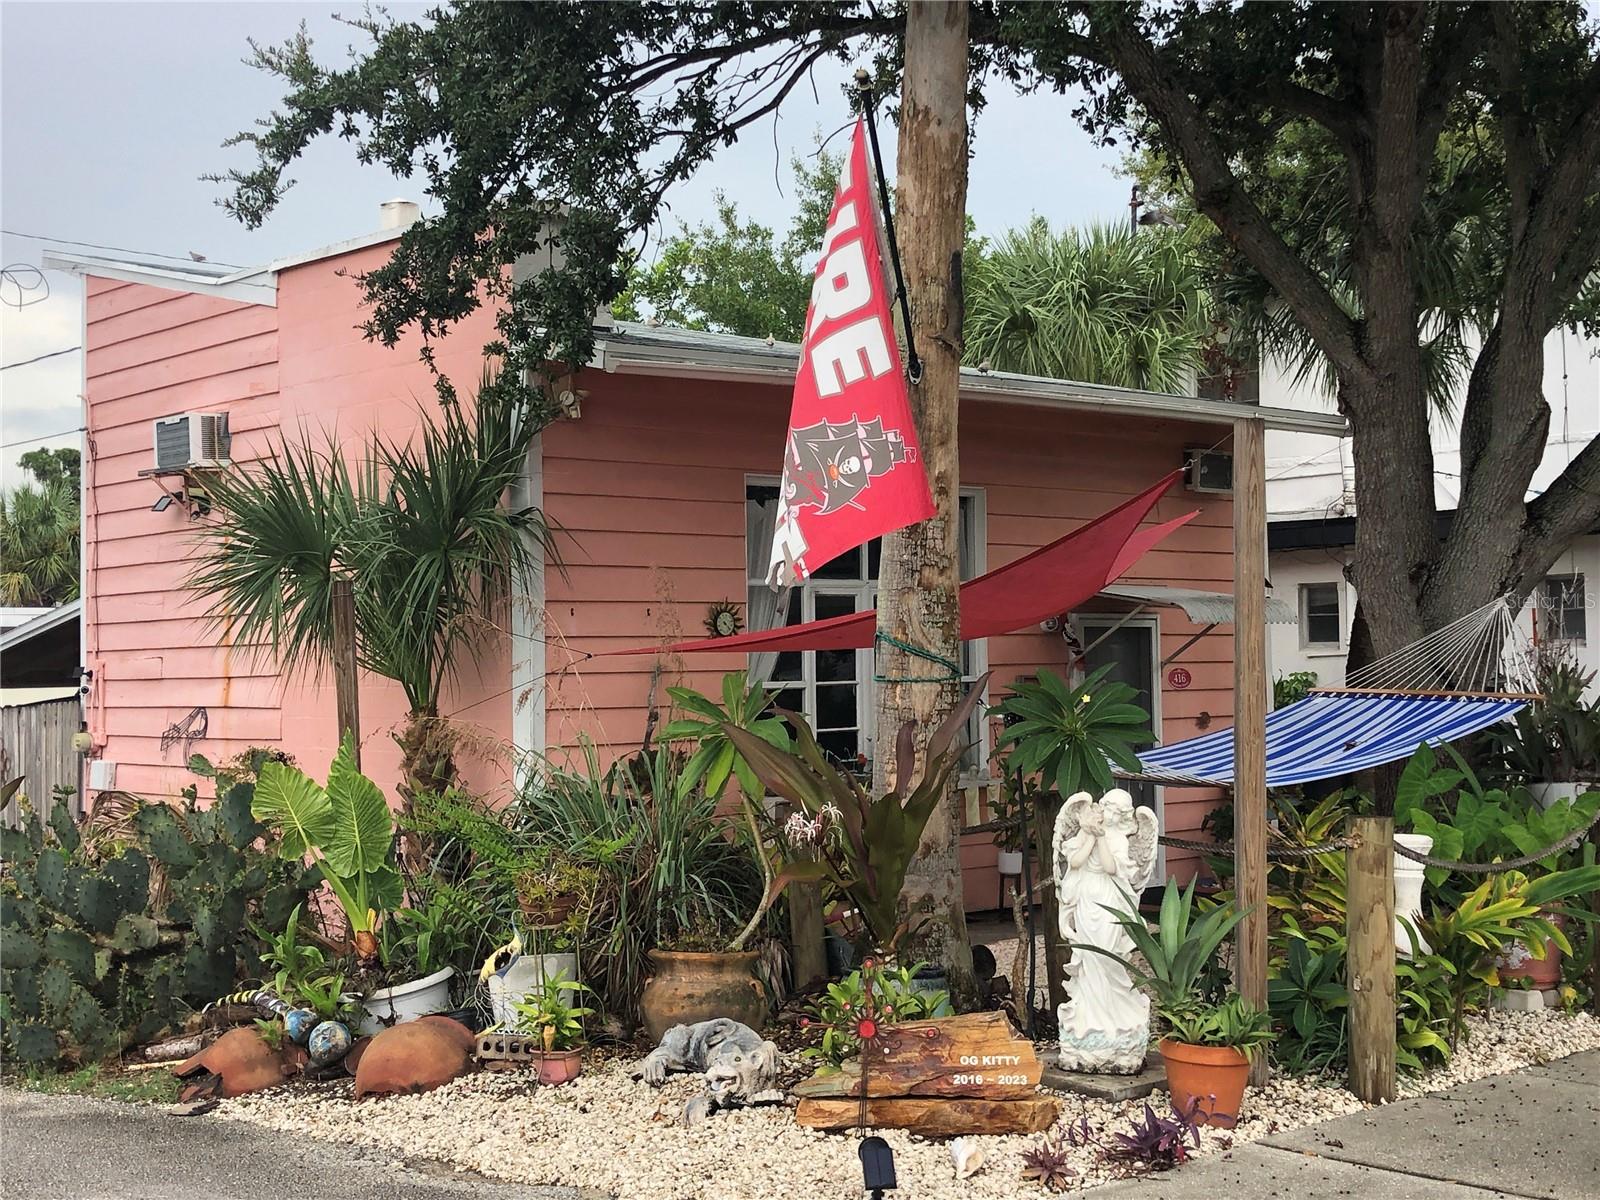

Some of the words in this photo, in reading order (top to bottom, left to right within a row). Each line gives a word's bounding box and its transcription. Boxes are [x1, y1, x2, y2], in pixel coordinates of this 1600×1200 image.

[805, 142, 893, 398] IRE
[1173, 673, 1187, 683] 416
[960, 1055, 978, 1065] OG
[982, 1055, 1020, 1065] KITTY
[998, 1074, 1028, 1085] 2023
